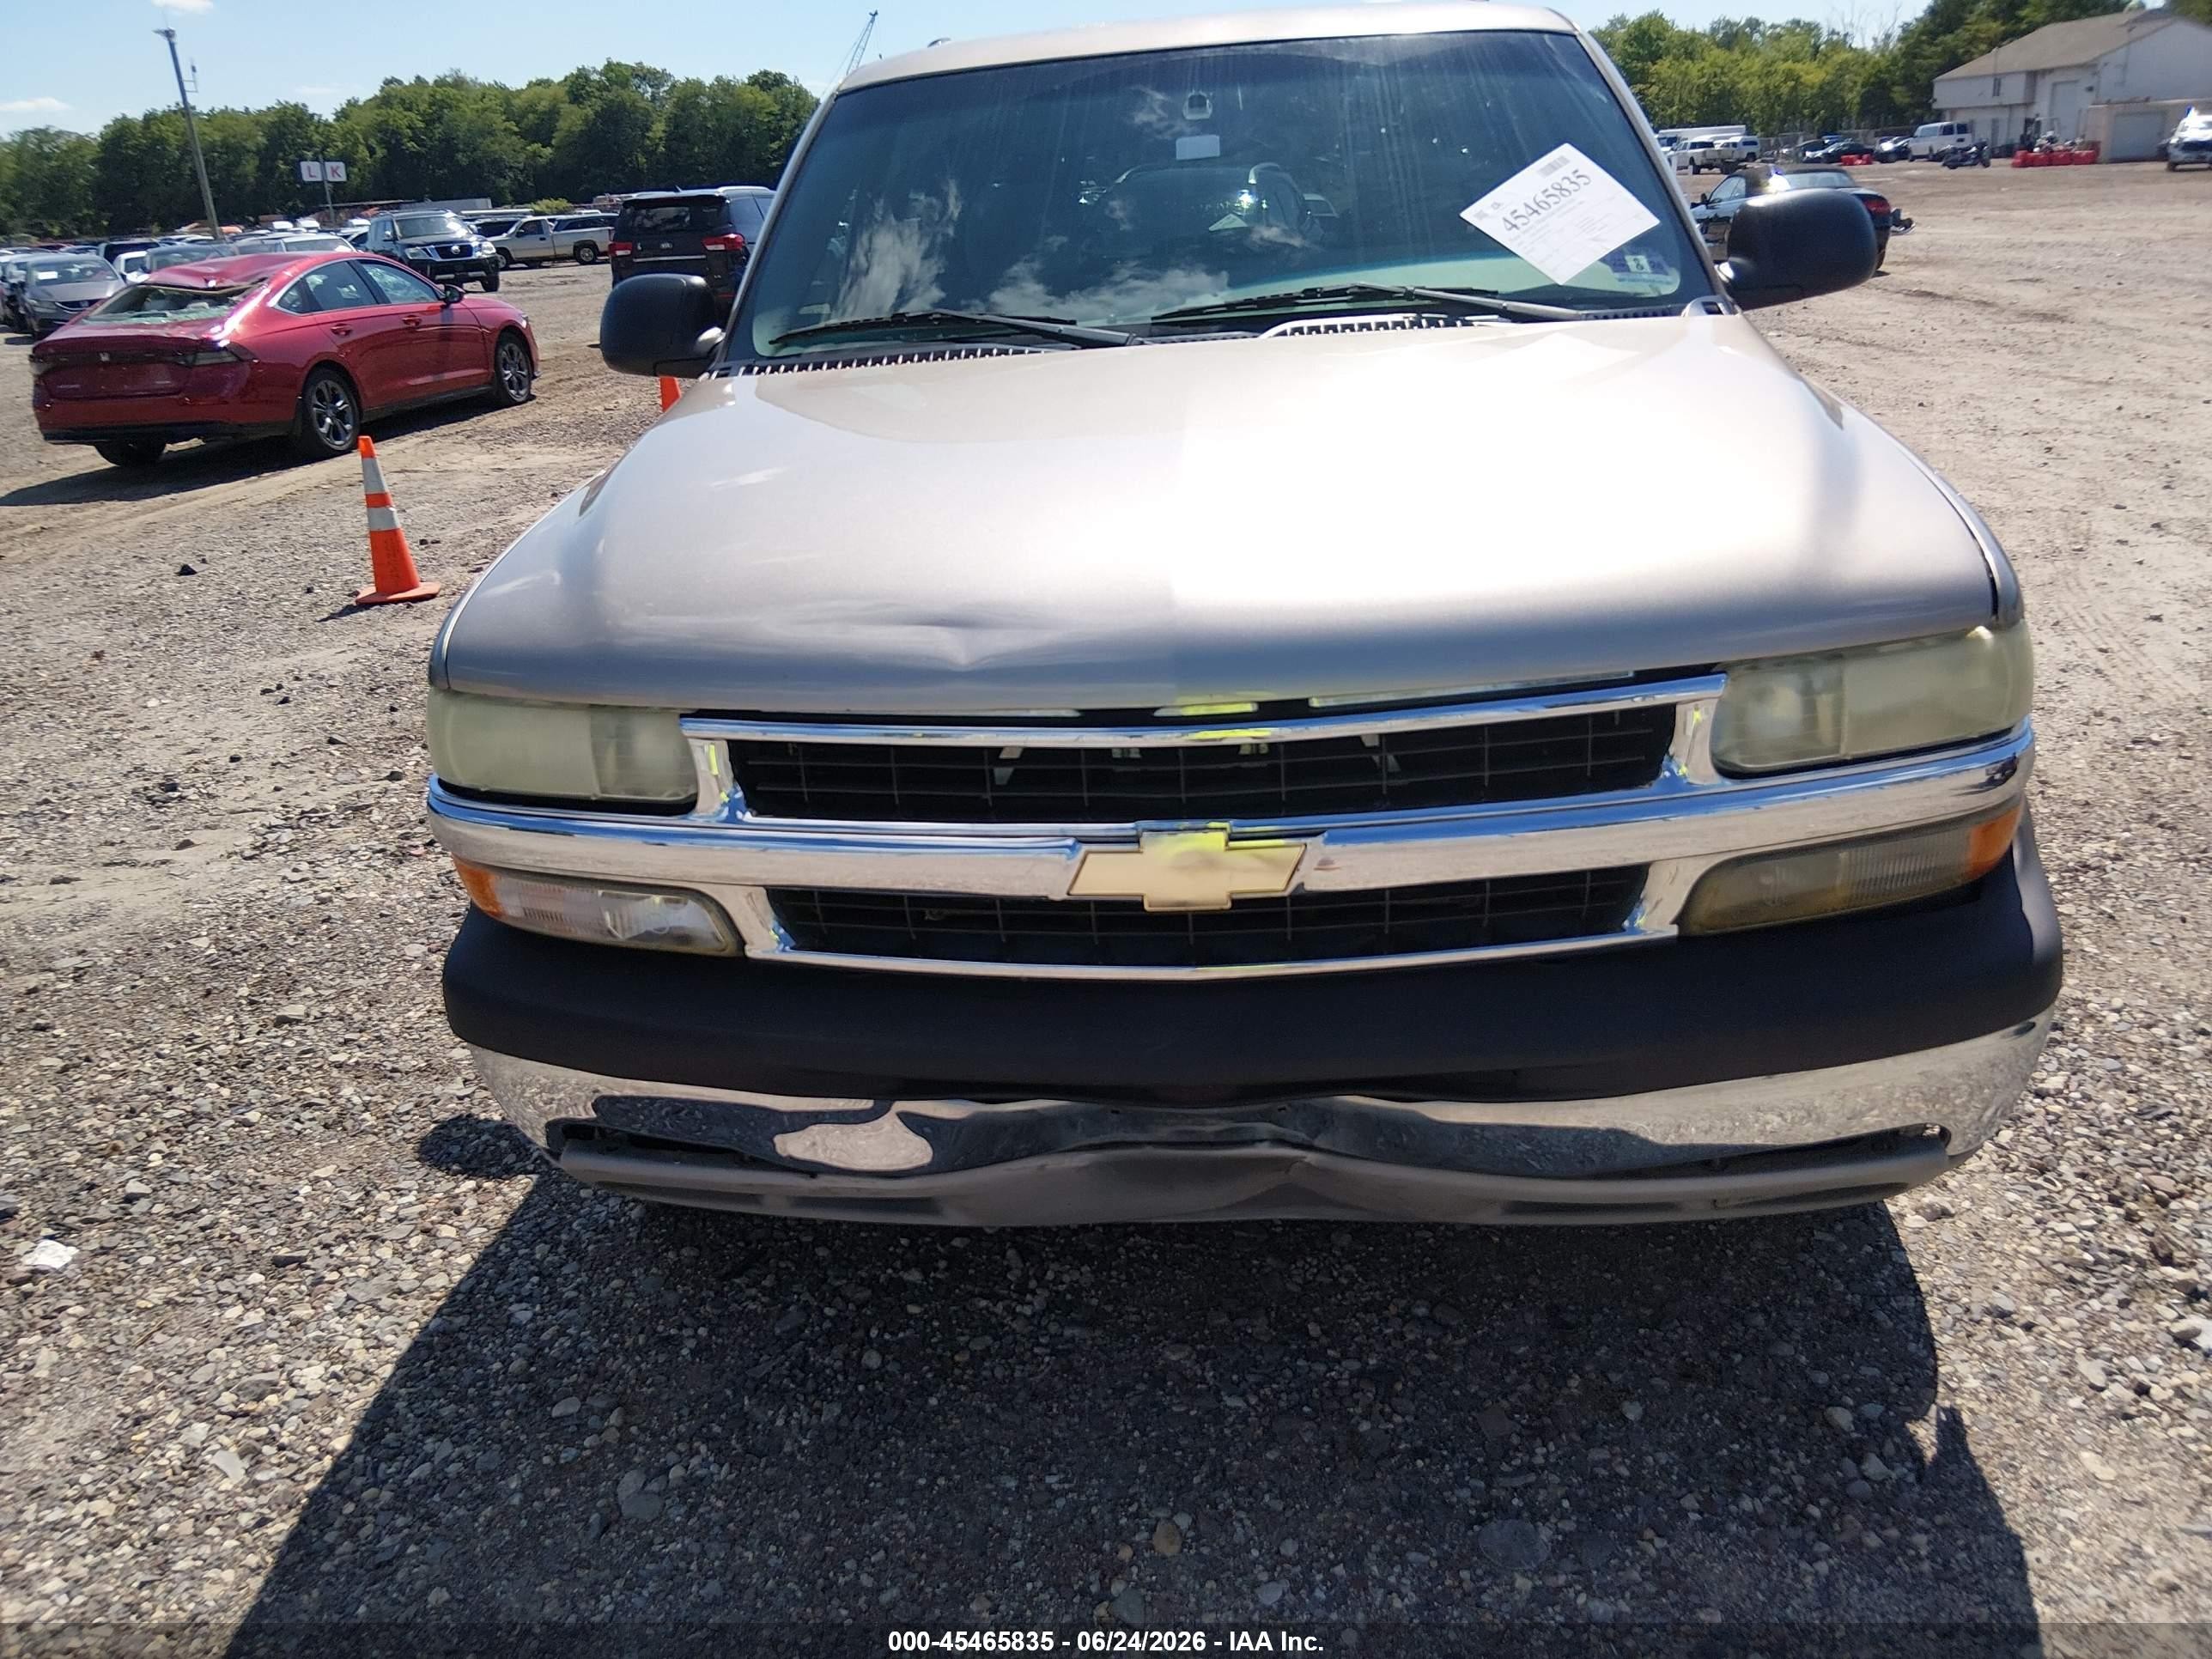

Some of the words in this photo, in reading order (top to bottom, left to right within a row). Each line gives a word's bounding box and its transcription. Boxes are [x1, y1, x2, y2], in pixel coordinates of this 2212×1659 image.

[307, 165, 317, 179] L
[330, 165, 343, 179] K
[1501, 169, 1593, 234] 45465835
